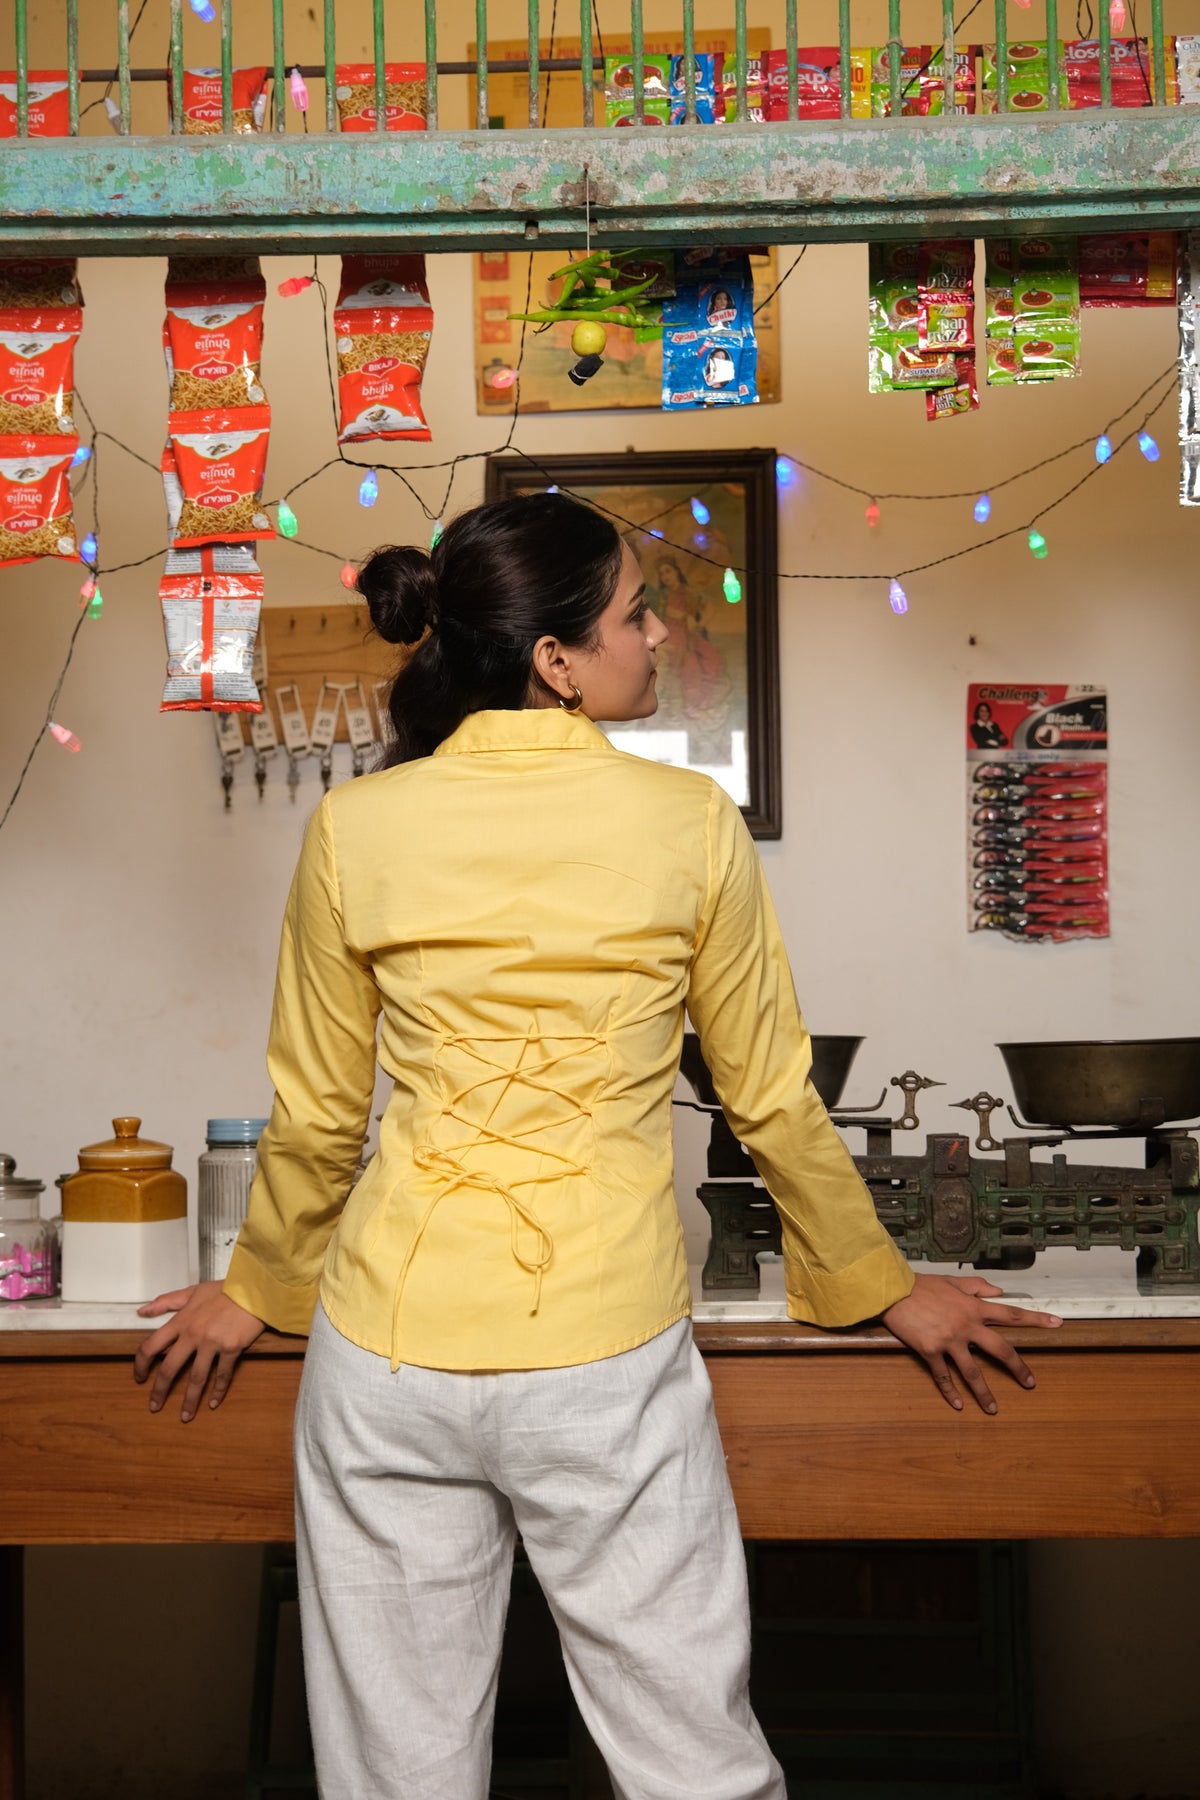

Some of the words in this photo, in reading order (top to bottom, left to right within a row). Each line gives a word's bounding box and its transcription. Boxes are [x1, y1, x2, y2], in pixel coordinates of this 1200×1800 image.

[747, 59, 761, 70] an
[954, 53, 969, 65] an
[722, 68, 761, 83] mza
[928, 64, 969, 76] mza
[193, 83, 222, 97] hujia
[194, 337, 230, 351] bhujia
[199, 366, 228, 376] BIKAJI
[368, 359, 393, 372] BIKAJI
[9, 366, 45, 378] bhujia
[362, 382, 394, 396] bhujia
[10, 393, 41, 402] BIKAJI
[200, 467, 235, 480] bhujia
[7, 492, 42, 504] bhujia
[203, 494, 232, 504] BIKAJI
[10, 519, 38, 528] BIKAJI
[1045, 712, 1084, 724] Black
